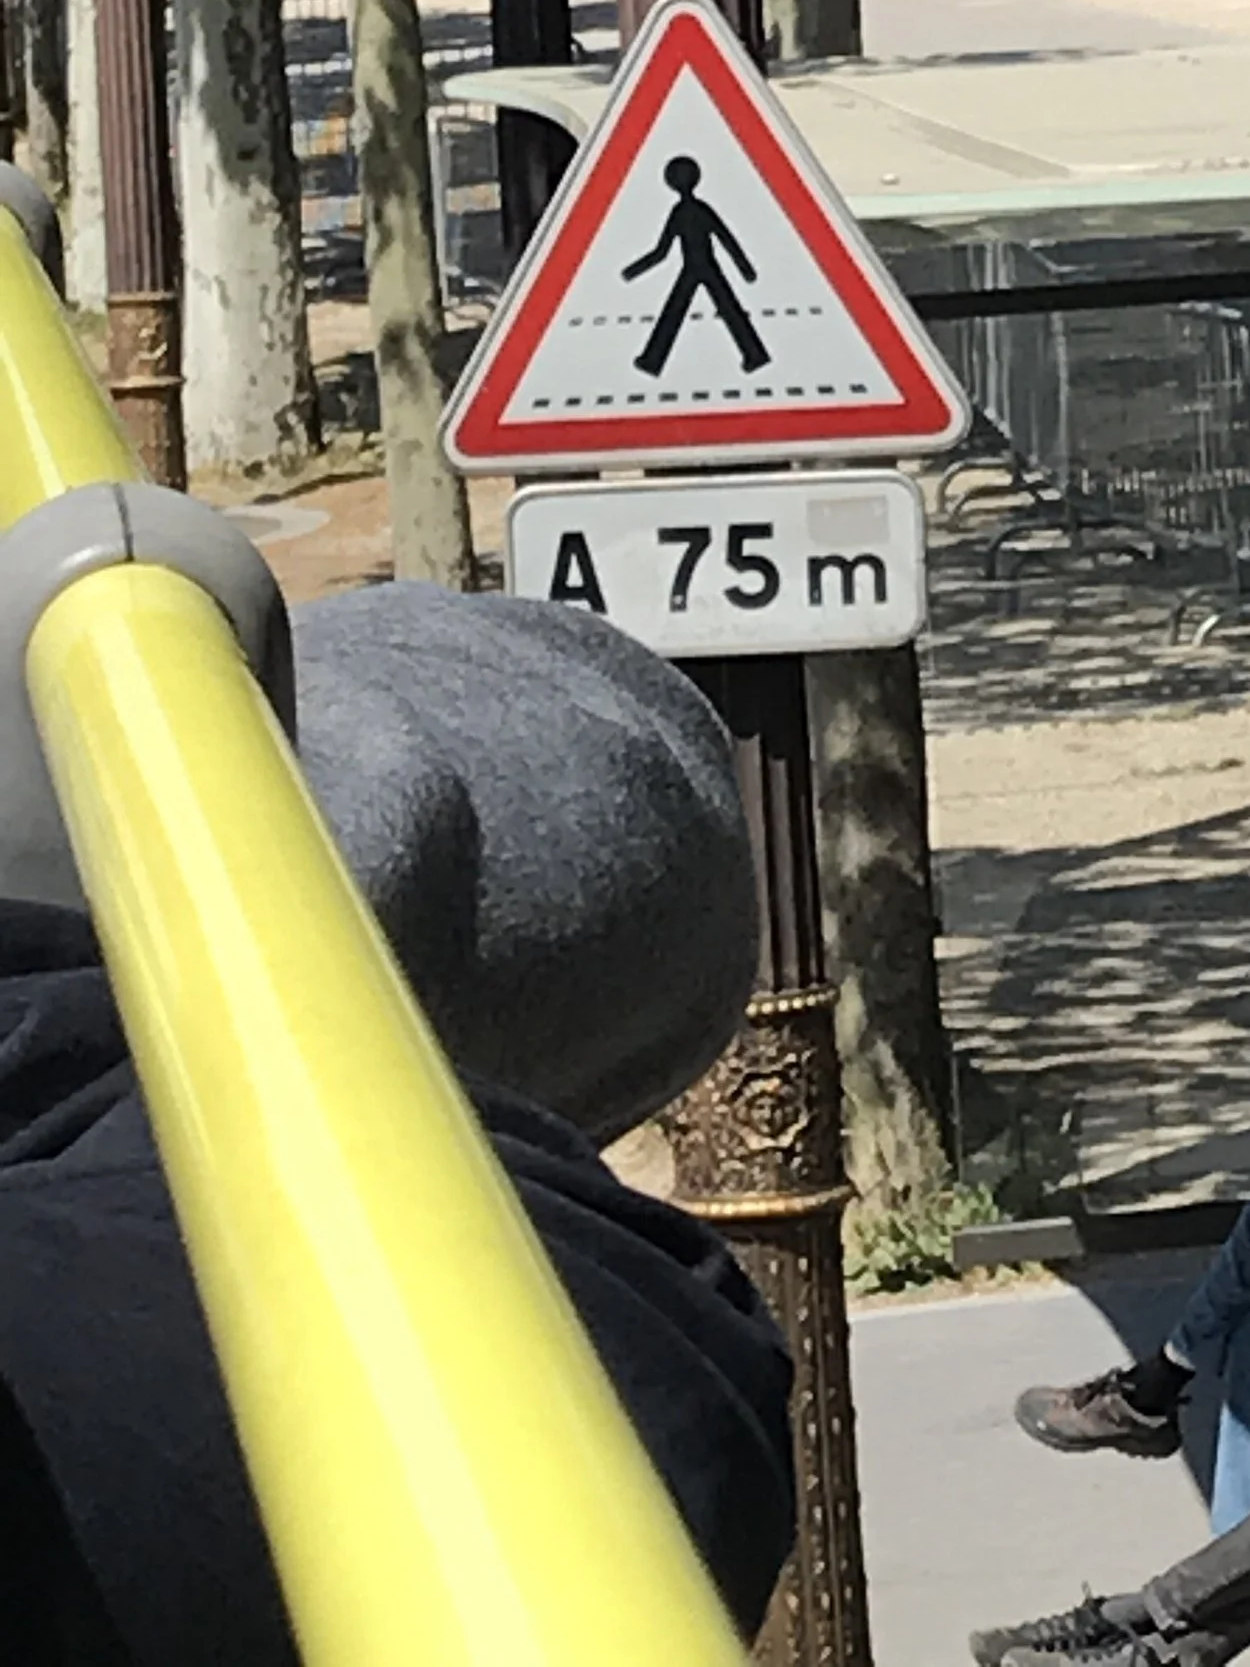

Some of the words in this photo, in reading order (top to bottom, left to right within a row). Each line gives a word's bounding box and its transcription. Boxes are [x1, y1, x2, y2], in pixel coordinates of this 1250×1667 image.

[549, 530, 608, 615] A
[658, 522, 780, 612] 75
[808, 553, 886, 607] m
